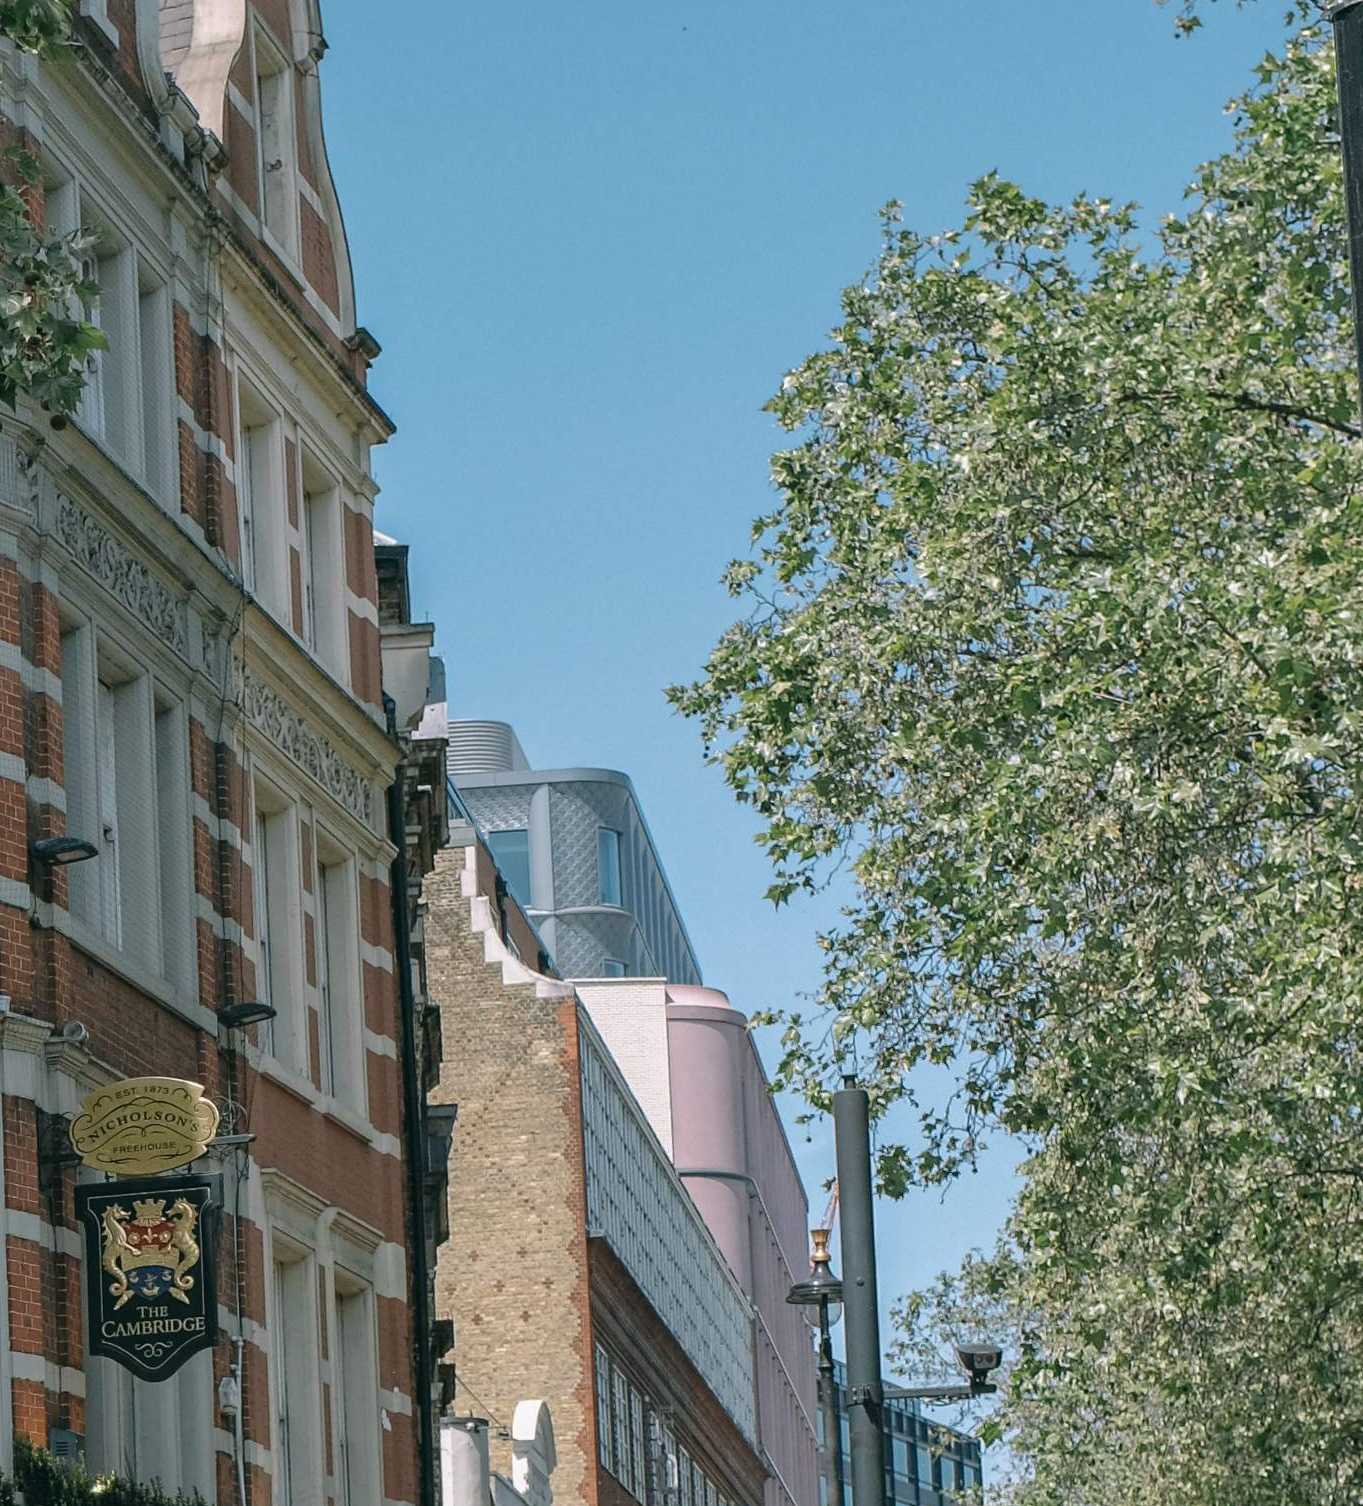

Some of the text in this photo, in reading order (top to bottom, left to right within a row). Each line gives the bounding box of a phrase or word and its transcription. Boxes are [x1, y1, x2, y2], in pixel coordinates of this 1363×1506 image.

[144, 1085, 170, 1097] 1873
[88, 1110, 200, 1144] NICHOLSON'S
[113, 1140, 176, 1154] FREEHOUSE
[136, 1305, 169, 1319] THE
[101, 1316, 206, 1338] CAMBRIDGE
